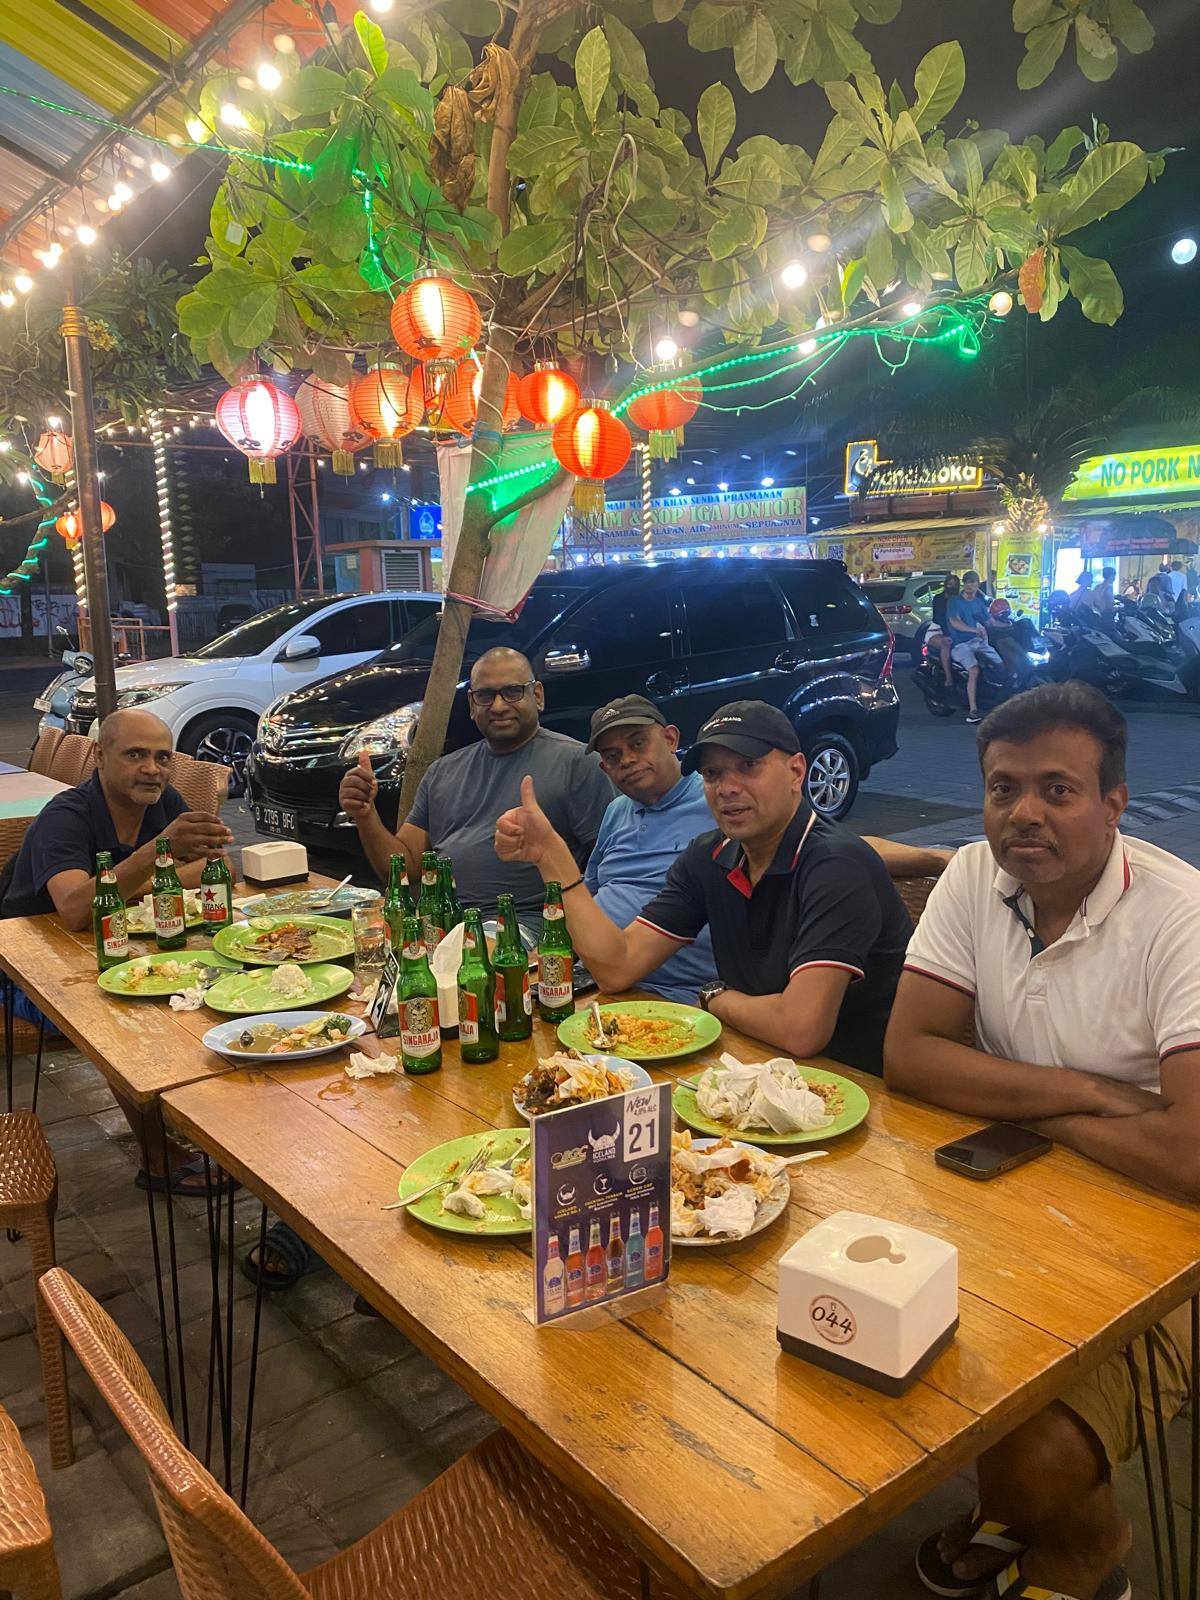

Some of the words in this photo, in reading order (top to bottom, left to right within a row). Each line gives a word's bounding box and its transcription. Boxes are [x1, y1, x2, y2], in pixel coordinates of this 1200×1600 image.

[1101, 463, 1126, 487] NO
[1131, 456, 1179, 484] PORK
[691, 494, 720, 504] SUNDA
[724, 490, 783, 502] PRASMANAN
[690, 503, 722, 522] IGA
[729, 498, 803, 522] JONTOR
[402, 1030, 439, 1046] SINGARAJA
[626, 1094, 652, 1113] NEW
[629, 1118, 655, 1154] 21
[592, 1147, 616, 1160] ICELAND
